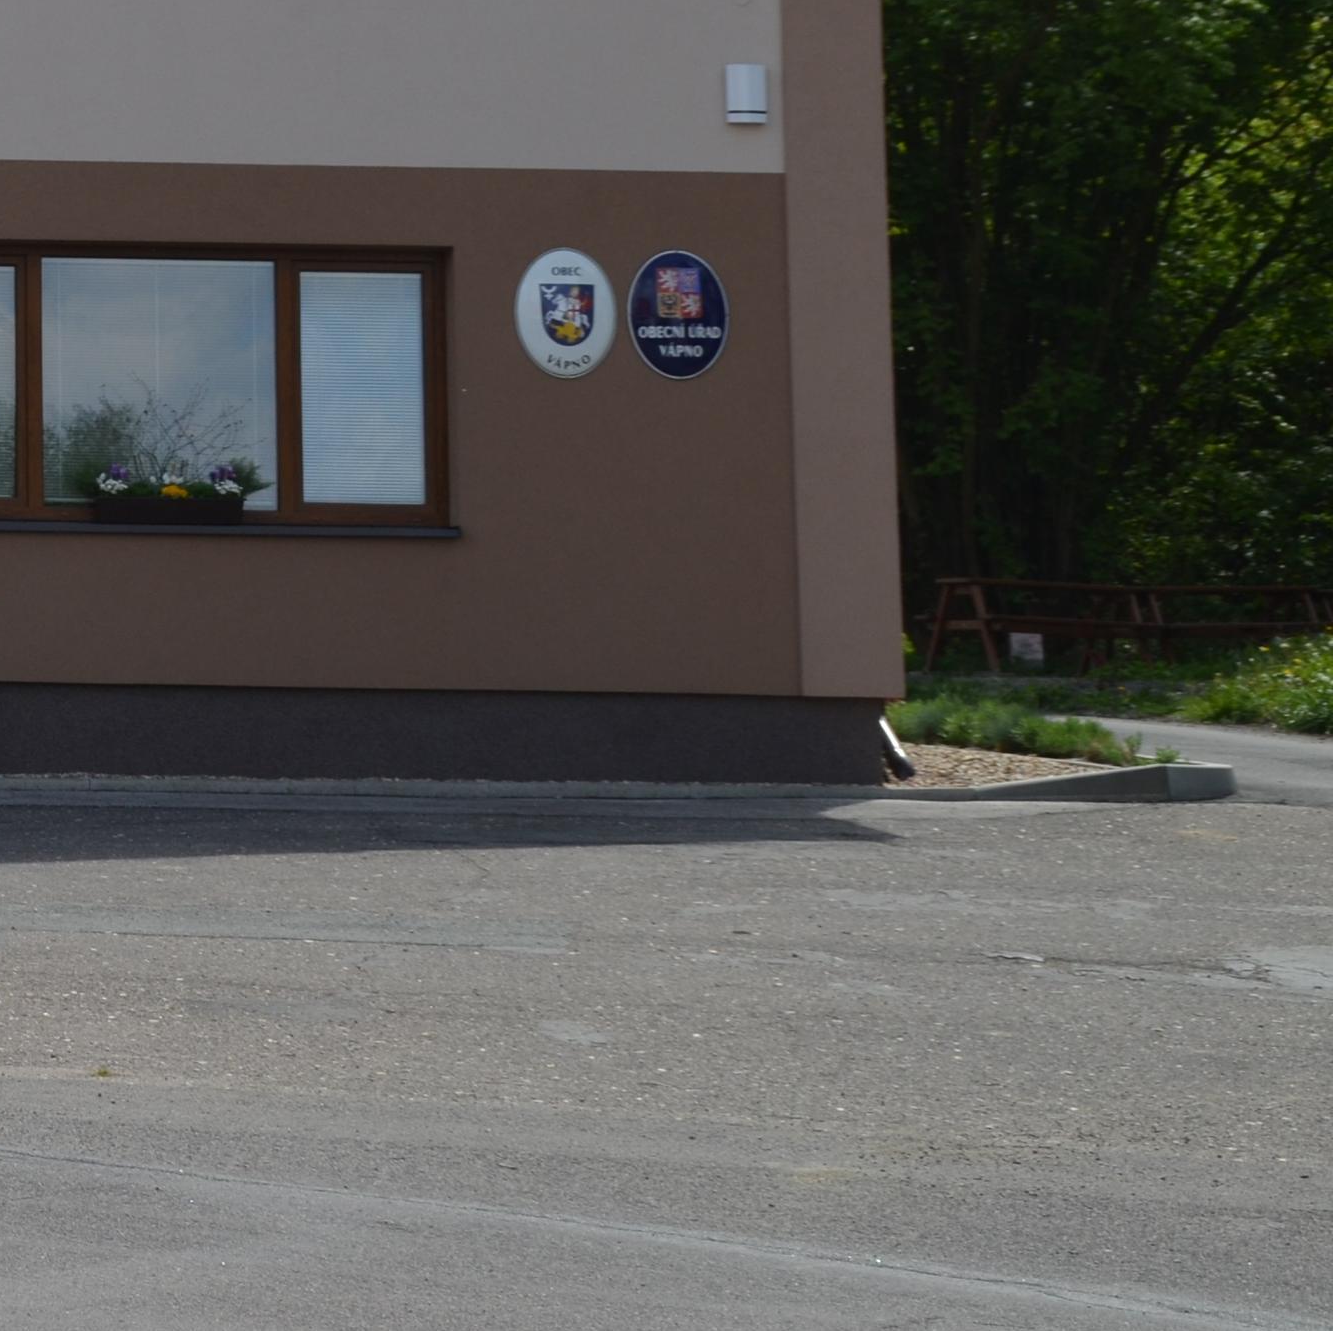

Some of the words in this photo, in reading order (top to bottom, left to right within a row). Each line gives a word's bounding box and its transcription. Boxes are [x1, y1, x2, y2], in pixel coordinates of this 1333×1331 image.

[550, 266, 582, 277] OBEC
[638, 324, 685, 338] OBECNÍ
[688, 324, 721, 338] ÚŘAD
[659, 343, 703, 357] VÁPNO
[547, 355, 591, 369] VÁPNO
